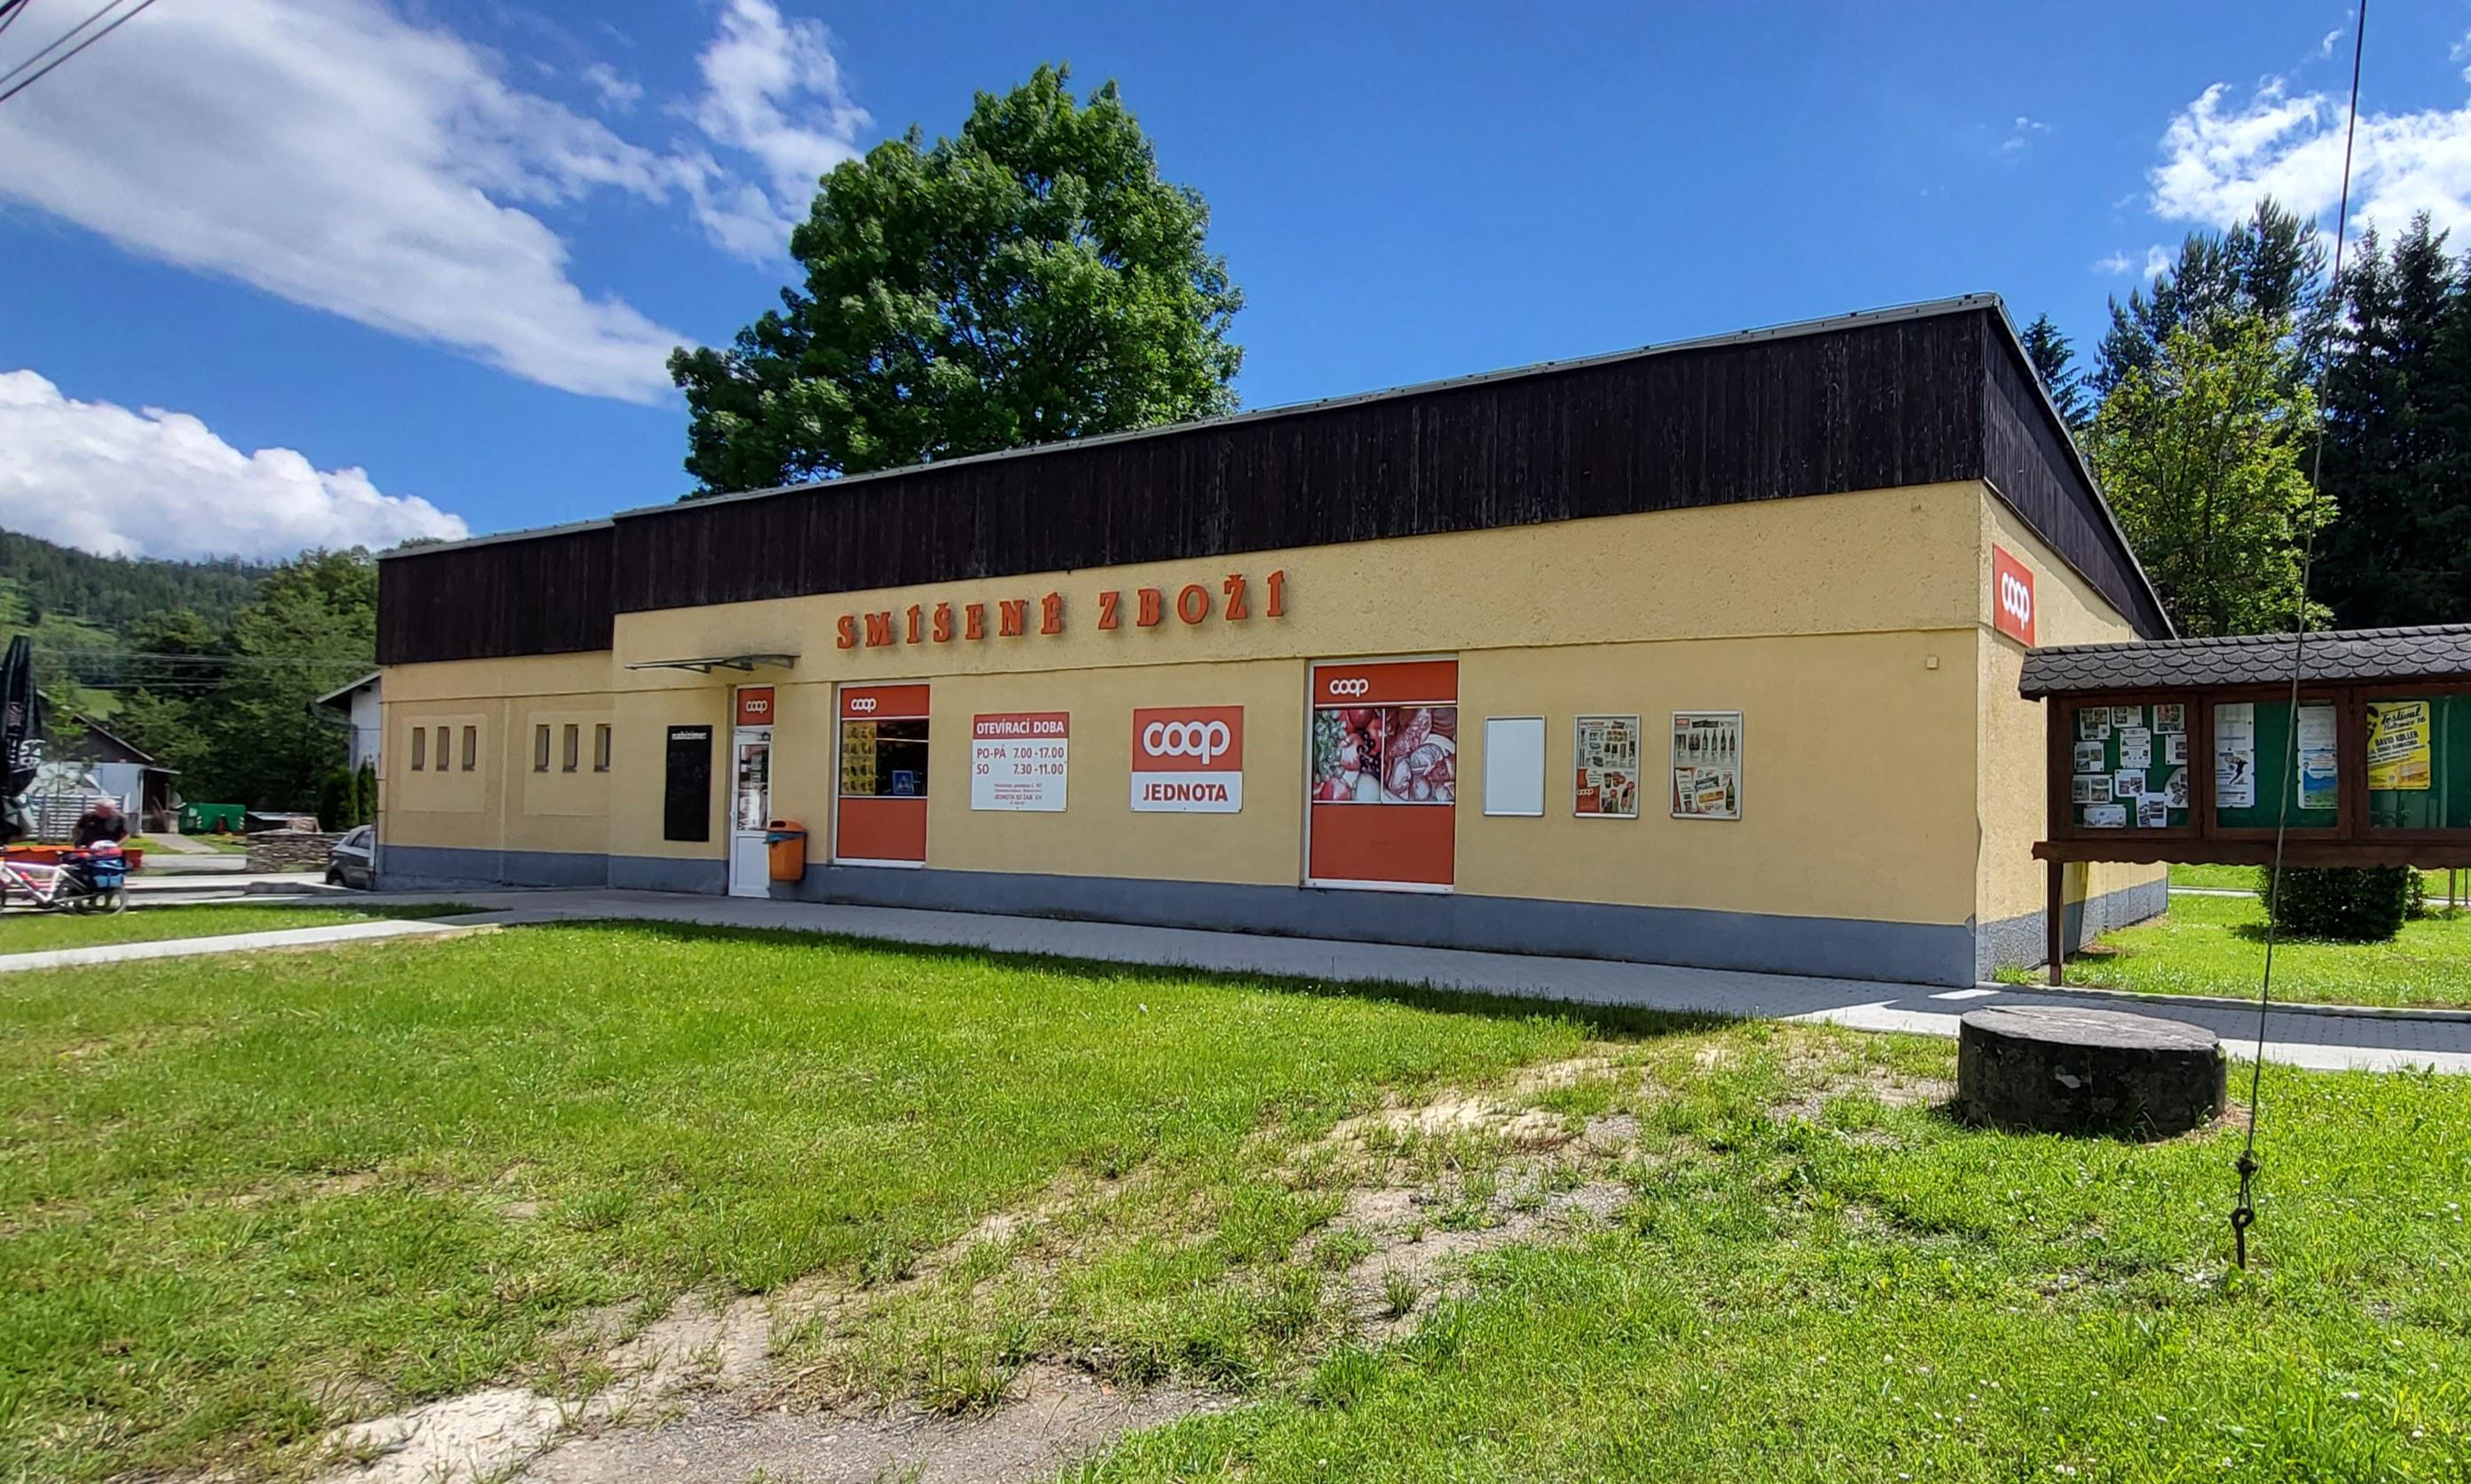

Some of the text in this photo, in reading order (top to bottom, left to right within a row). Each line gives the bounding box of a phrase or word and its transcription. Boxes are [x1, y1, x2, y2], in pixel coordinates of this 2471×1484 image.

[837, 569, 1286, 649] SMÍŠENÉ ZBOŽÍ
[2002, 571, 2030, 630] coop
[1329, 678, 1369, 697] coop
[745, 700, 767, 714] coop
[850, 697, 877, 713] coop
[976, 718, 1065, 734] OTEVÍRACÍ DOBA
[1142, 719, 1232, 766] coop
[976, 744, 1006, 759] PO-PÁ
[1012, 747, 1033, 759] 7.00
[976, 764, 989, 775] SO
[1012, 763, 1033, 775] 7.30
[1142, 782, 1229, 803] JEDNOTA
